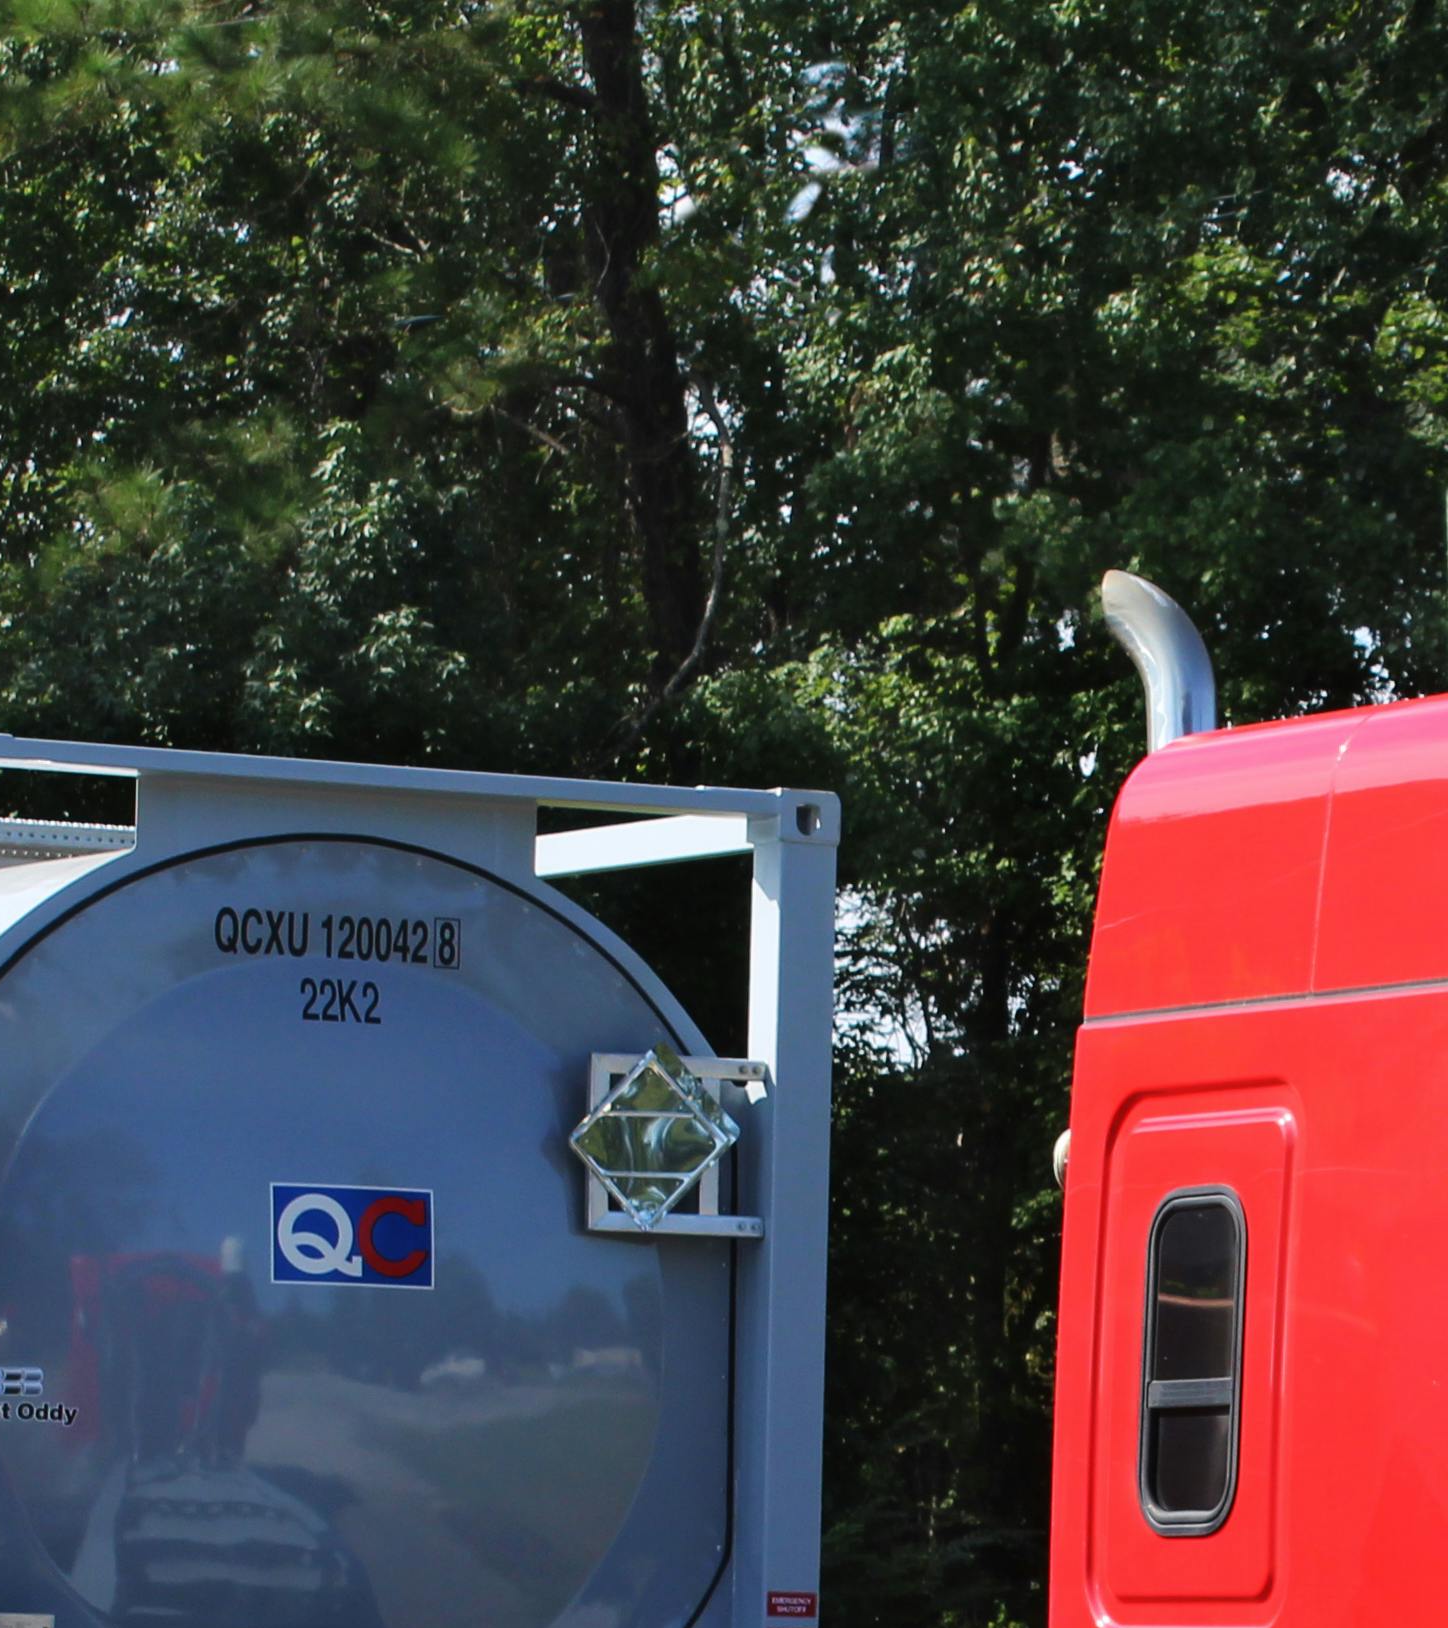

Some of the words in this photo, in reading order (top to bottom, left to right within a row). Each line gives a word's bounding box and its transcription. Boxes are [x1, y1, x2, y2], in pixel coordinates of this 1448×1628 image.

[215, 907, 309, 957] QCXU
[321, 914, 428, 964] 120042
[300, 978, 382, 1025] 22K2
[277, 1192, 428, 1278] QC
[17, 1402, 78, 1426] Oddy
